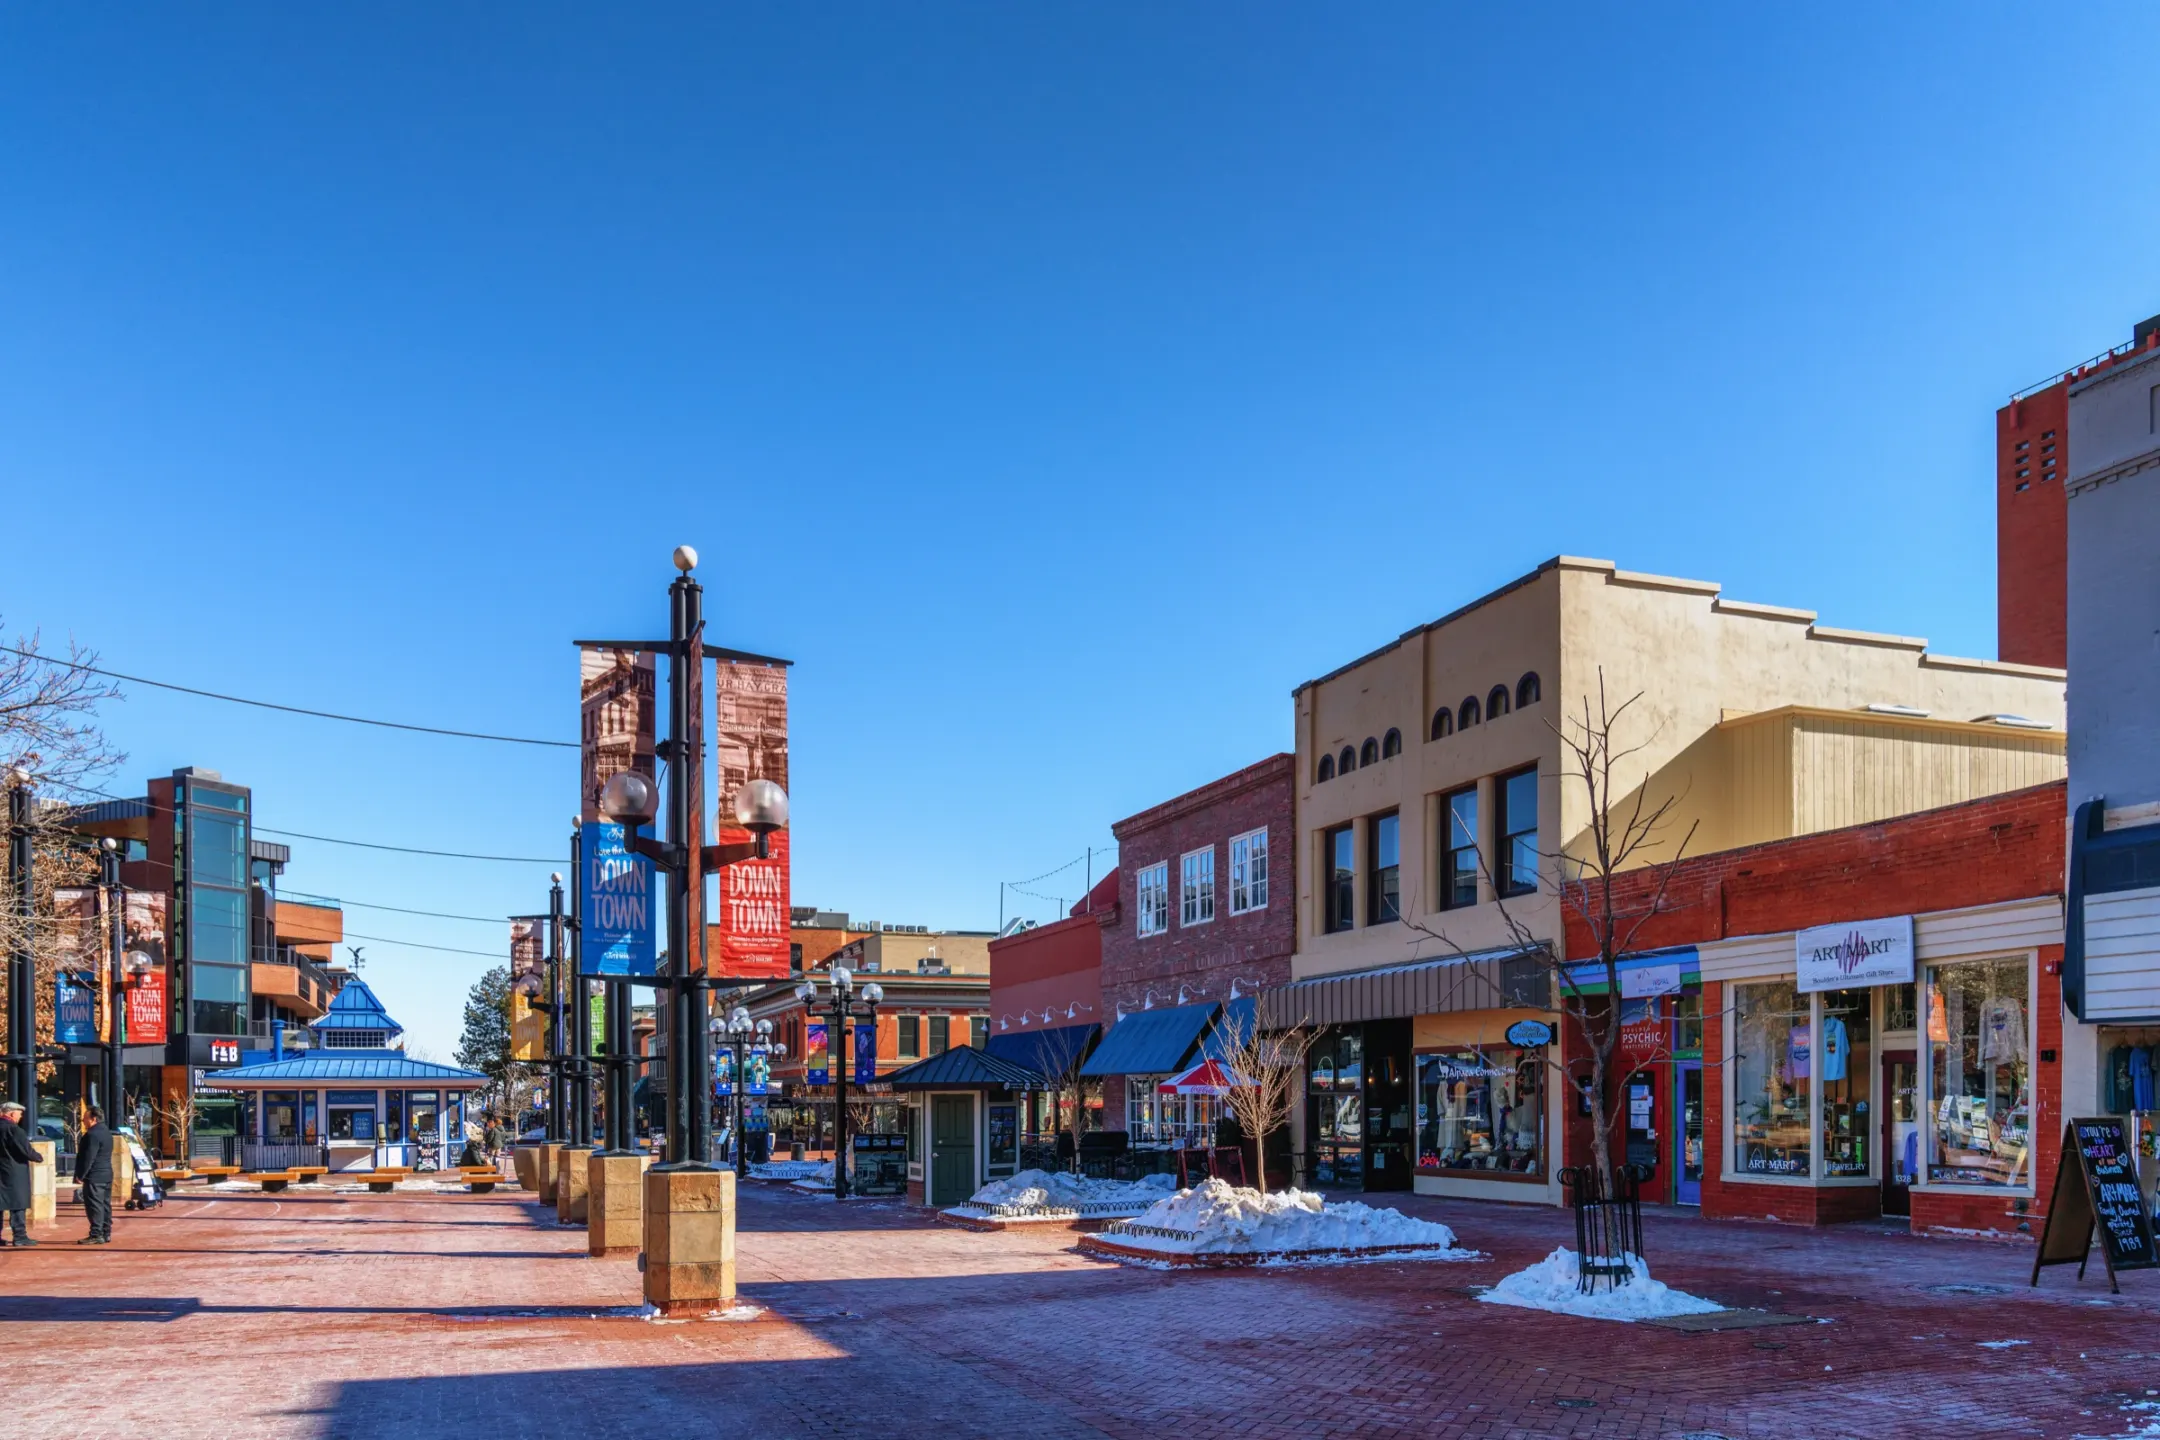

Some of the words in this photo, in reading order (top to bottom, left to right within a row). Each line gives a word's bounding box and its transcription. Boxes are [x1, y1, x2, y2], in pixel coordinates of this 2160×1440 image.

[592, 857, 646, 894] DOWN
[729, 863, 781, 899] DOWN
[591, 894, 647, 931] TOWN
[728, 899, 781, 934] TOWN
[1811, 945, 1841, 962] ART
[1846, 938, 1892, 957] MART
[1865, 971, 1877, 979] Gift
[1878, 969, 1895, 977] Store
[60, 987, 90, 1005] DOWN
[132, 989, 161, 1006] DOWN
[61, 1005, 90, 1021] TOWN
[132, 1005, 161, 1022] TOWN
[1622, 1032, 1661, 1044] PSYCHIC
[211, 1046, 238, 1062] F&B
[1449, 1066, 1473, 1079] Alpaca
[1190, 1085, 1215, 1094] Coca-Cola
[420, 1148, 436, 1157] SOUP
[2088, 1145, 2115, 1159] HEART
[1748, 1160, 1767, 1169] ART
[1769, 1160, 1795, 1170] MART
[1827, 1163, 1866, 1172] JEWELRY
[1895, 1174, 1912, 1183] 1328
[2118, 1203, 2141, 1217] Owned
[2118, 1236, 2142, 1252] 1989
